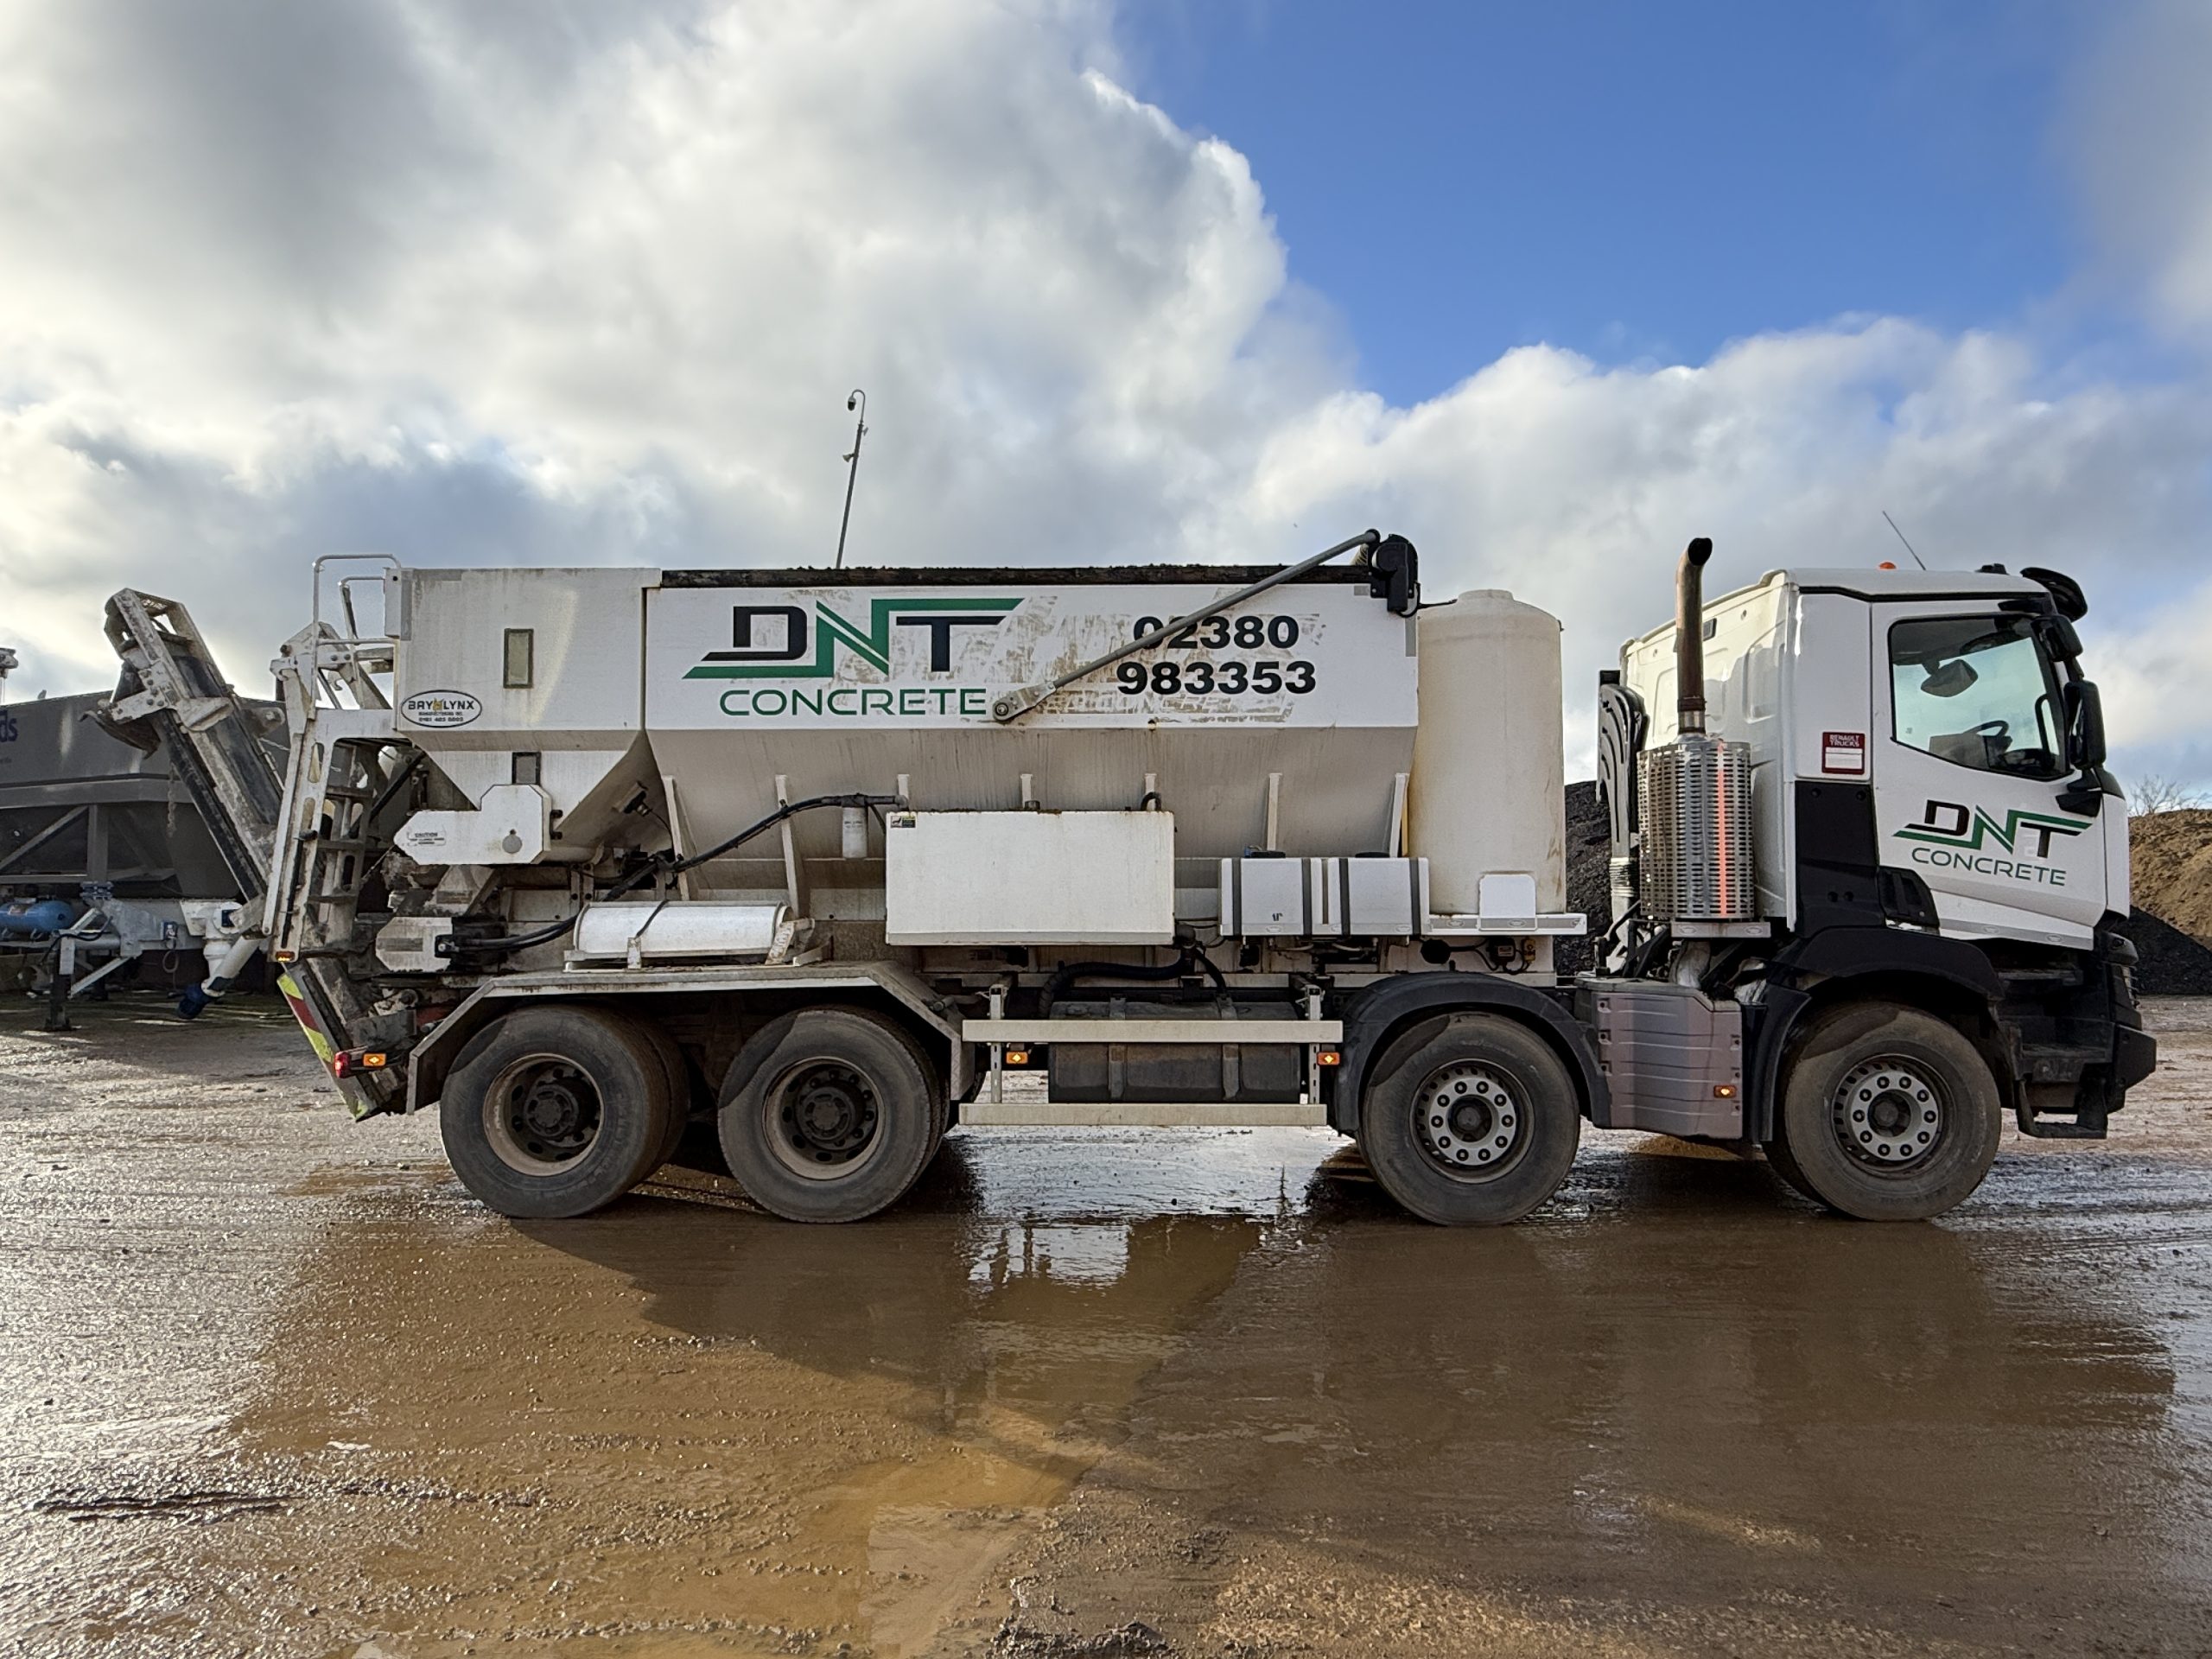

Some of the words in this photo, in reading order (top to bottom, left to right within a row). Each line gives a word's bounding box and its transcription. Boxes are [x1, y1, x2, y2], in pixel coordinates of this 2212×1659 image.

[682, 598, 1026, 680] DNT
[1133, 614, 1300, 650] 02380
[1116, 660, 1317, 696] 983353
[719, 689, 987, 716] CONCRETE
[1892, 799, 2093, 859] DNT
[1911, 847, 2067, 887] CONCRETE
